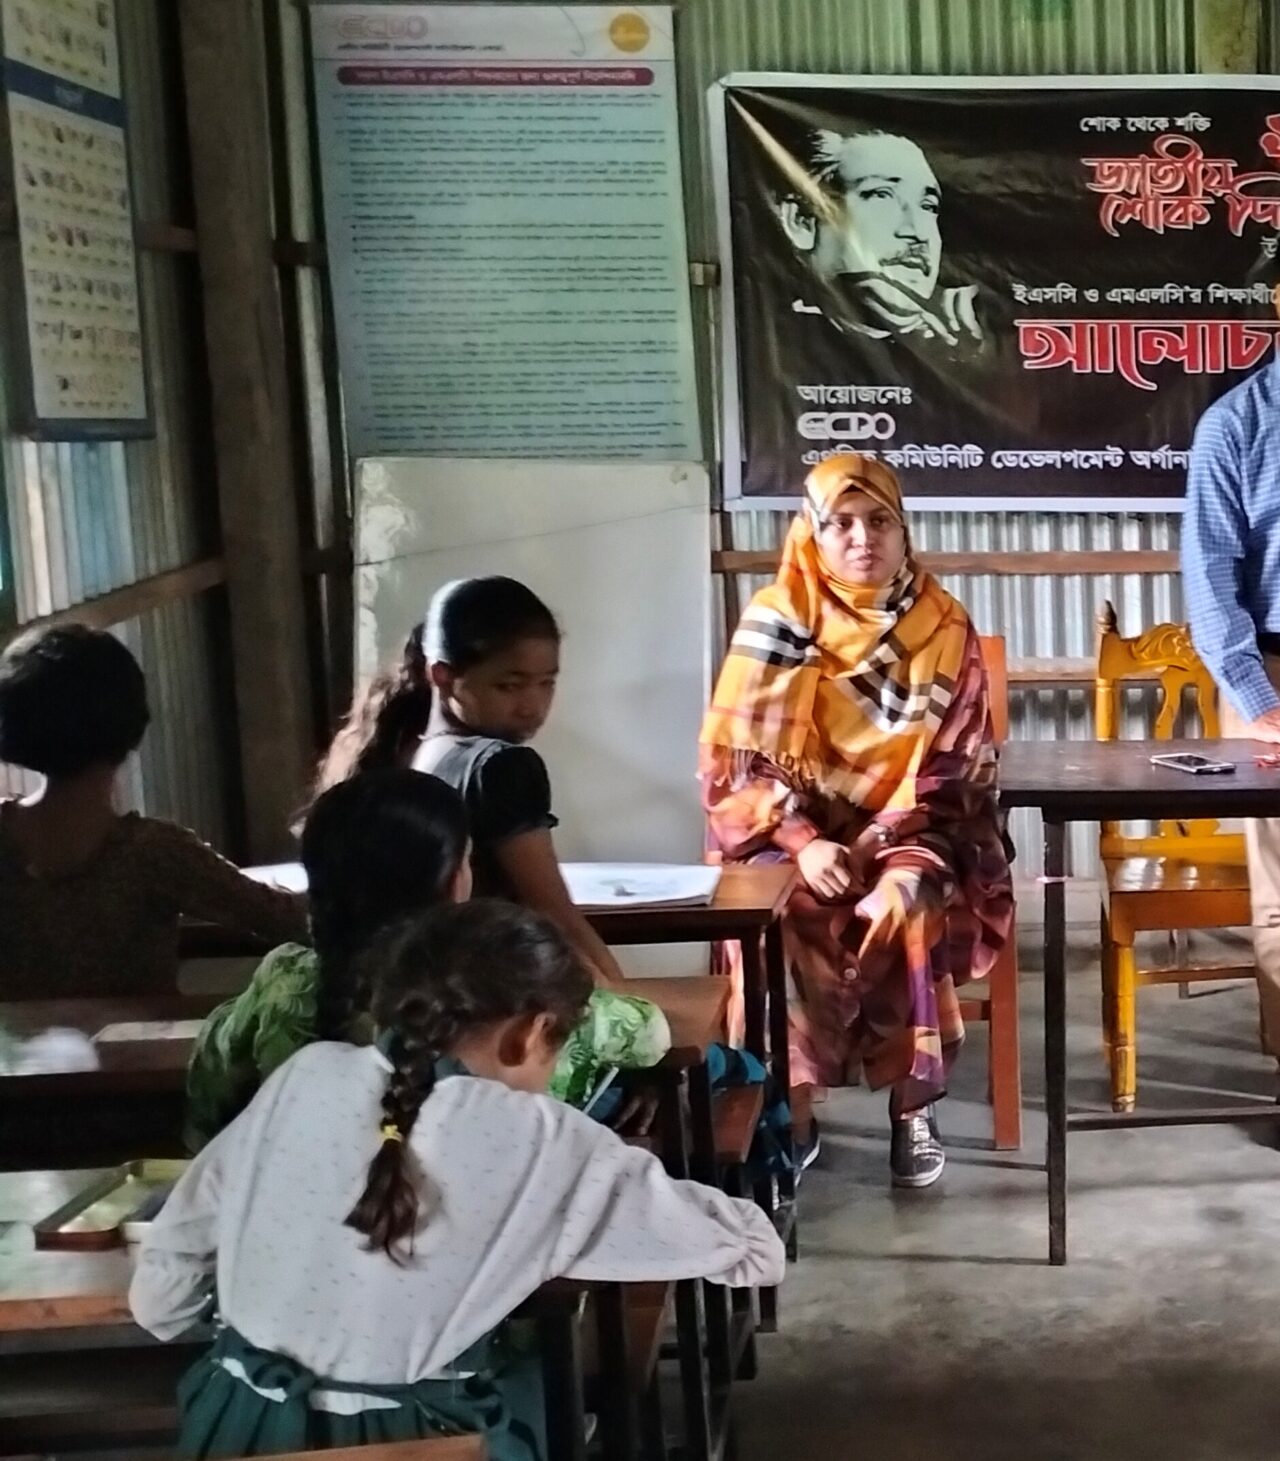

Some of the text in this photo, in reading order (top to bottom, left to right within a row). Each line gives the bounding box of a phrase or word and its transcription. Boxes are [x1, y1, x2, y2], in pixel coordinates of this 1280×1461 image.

[1080, 112, 1212, 132] শোক থেকে শক্তি
[1081, 134, 1238, 199] জাতীয়
[1100, 194, 1215, 237] শোক
[1012, 282, 1077, 305] ইএসসি
[1083, 288, 1099, 302] ও
[797, 411, 896, 440] ECDO
[883, 444, 985, 469] কমিউনিটি
[990, 445, 1125, 469] ডেভেলপমেন্ট
